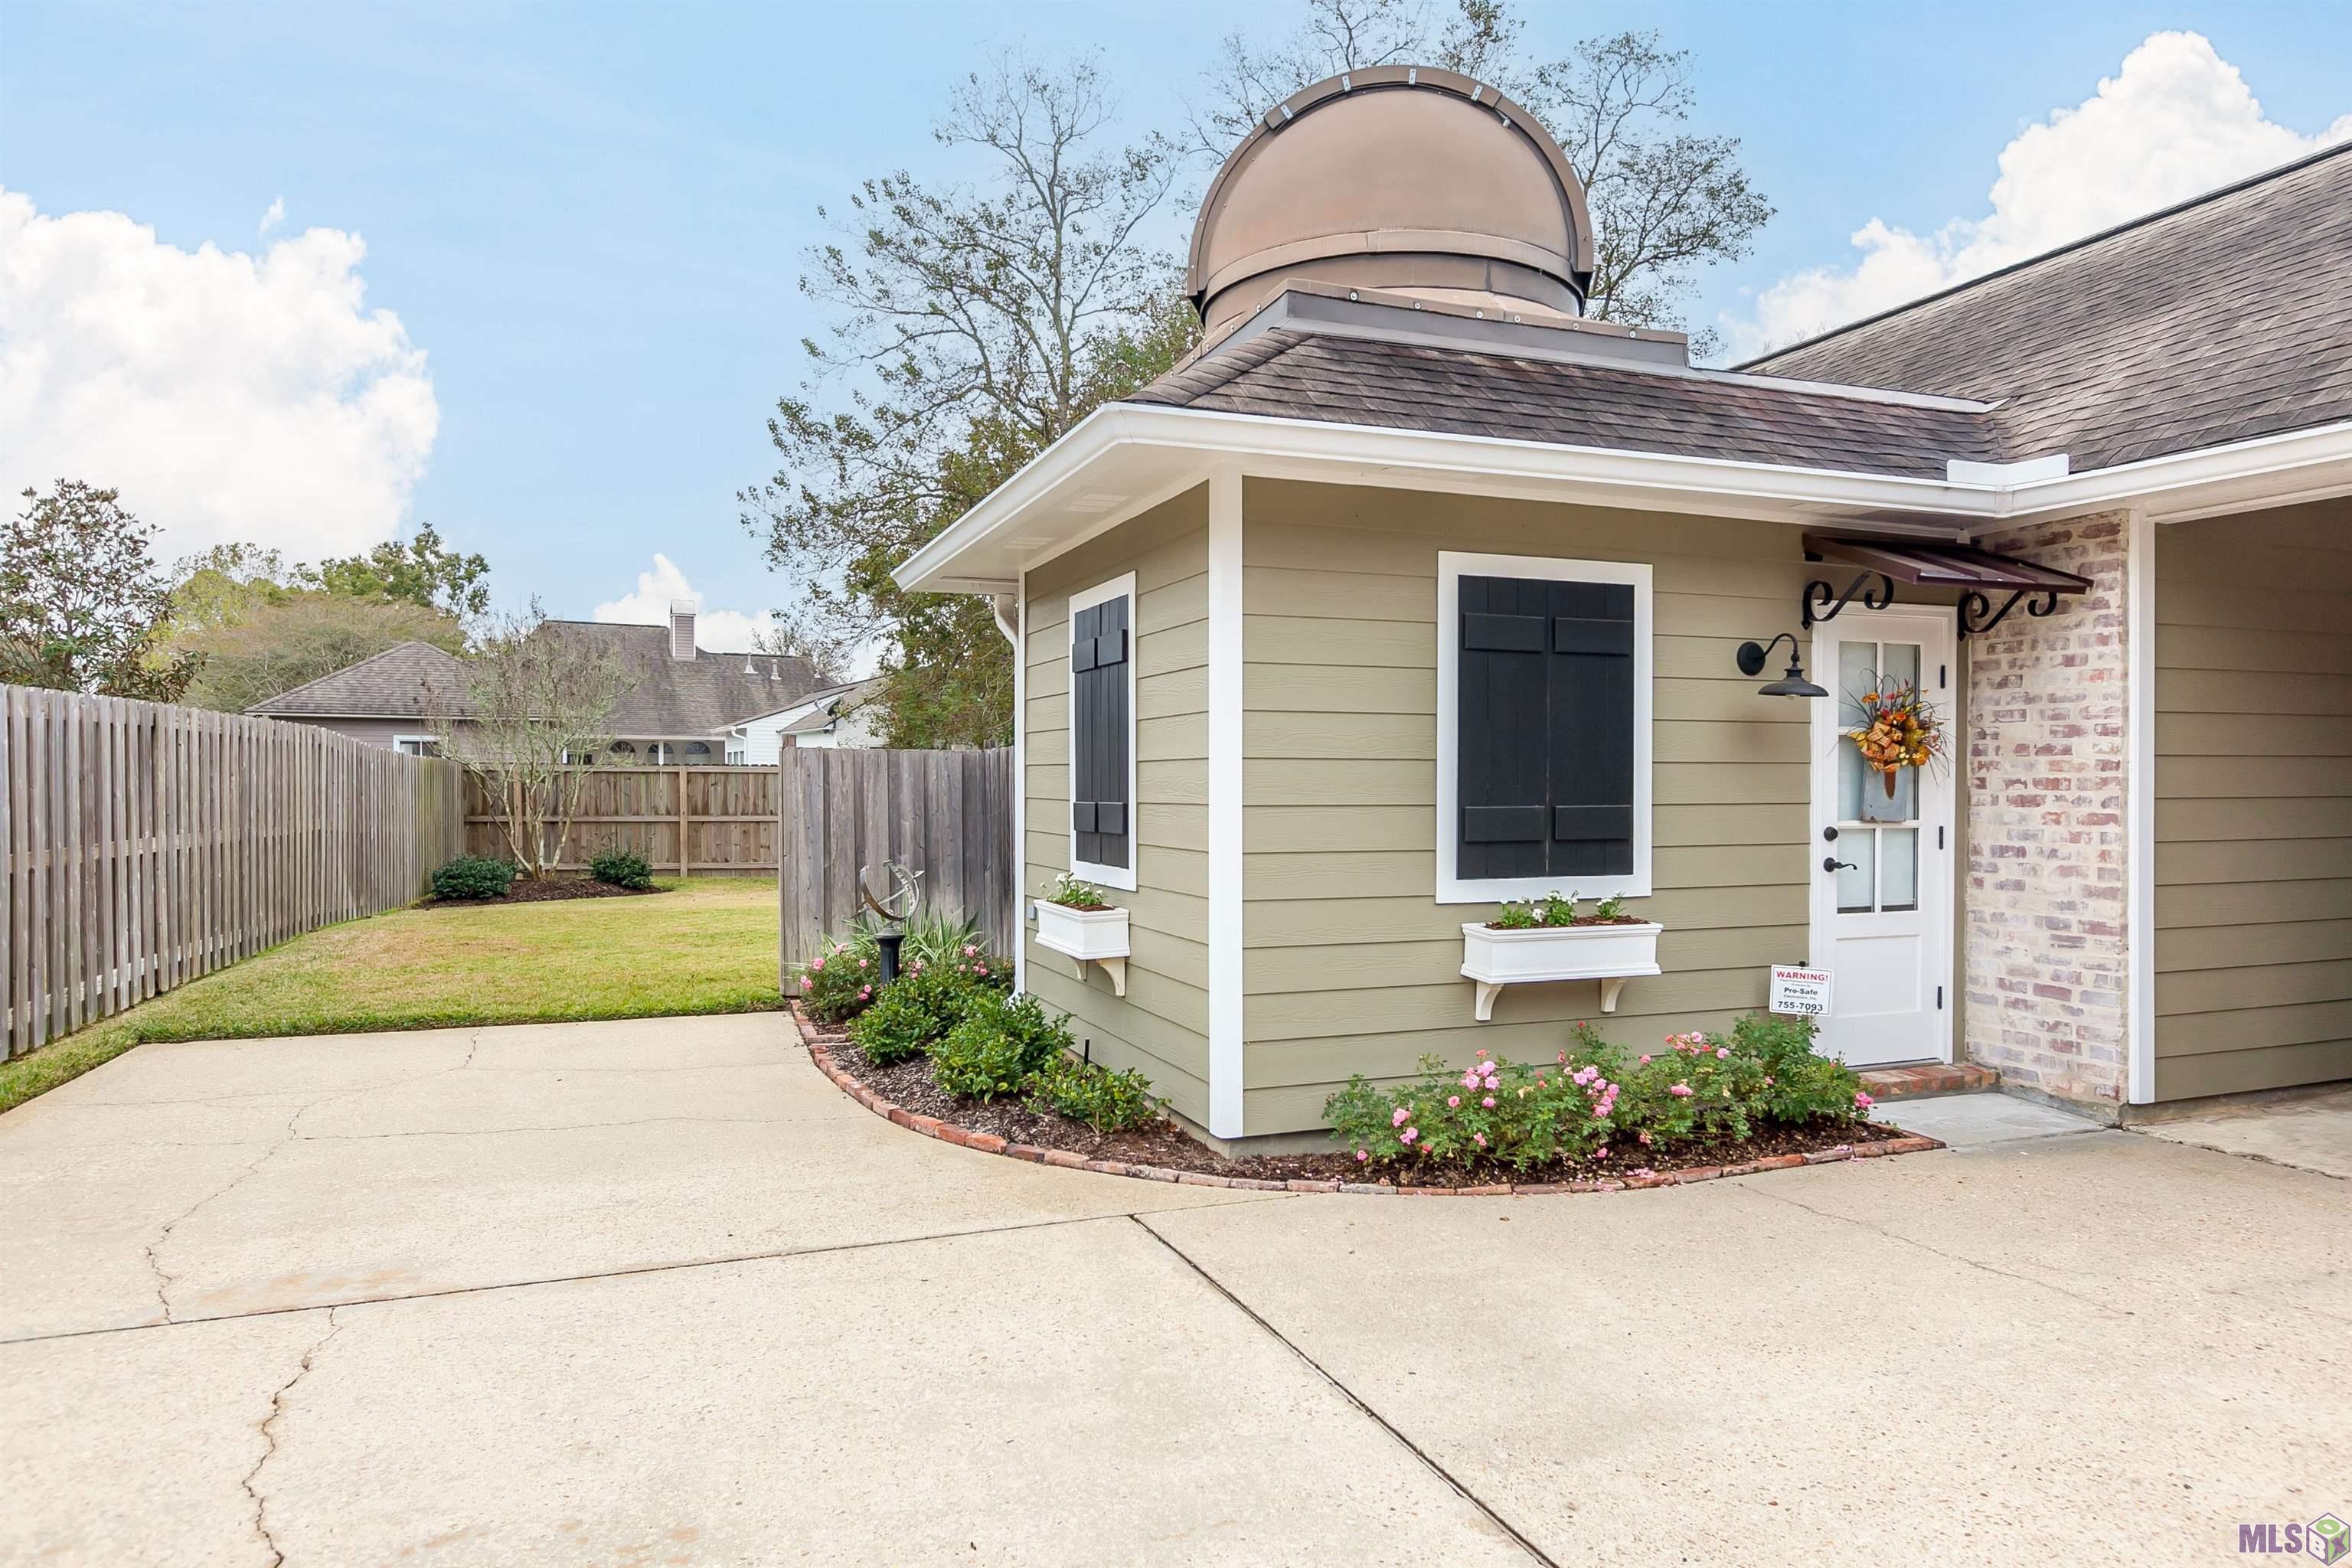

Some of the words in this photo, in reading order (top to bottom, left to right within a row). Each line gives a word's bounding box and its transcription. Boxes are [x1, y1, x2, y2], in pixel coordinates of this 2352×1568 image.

[1776, 971, 1828, 982] WARNING!
[1784, 987, 1818, 995] Pro-Safe
[1778, 1001, 1823, 1011] 755-7093
